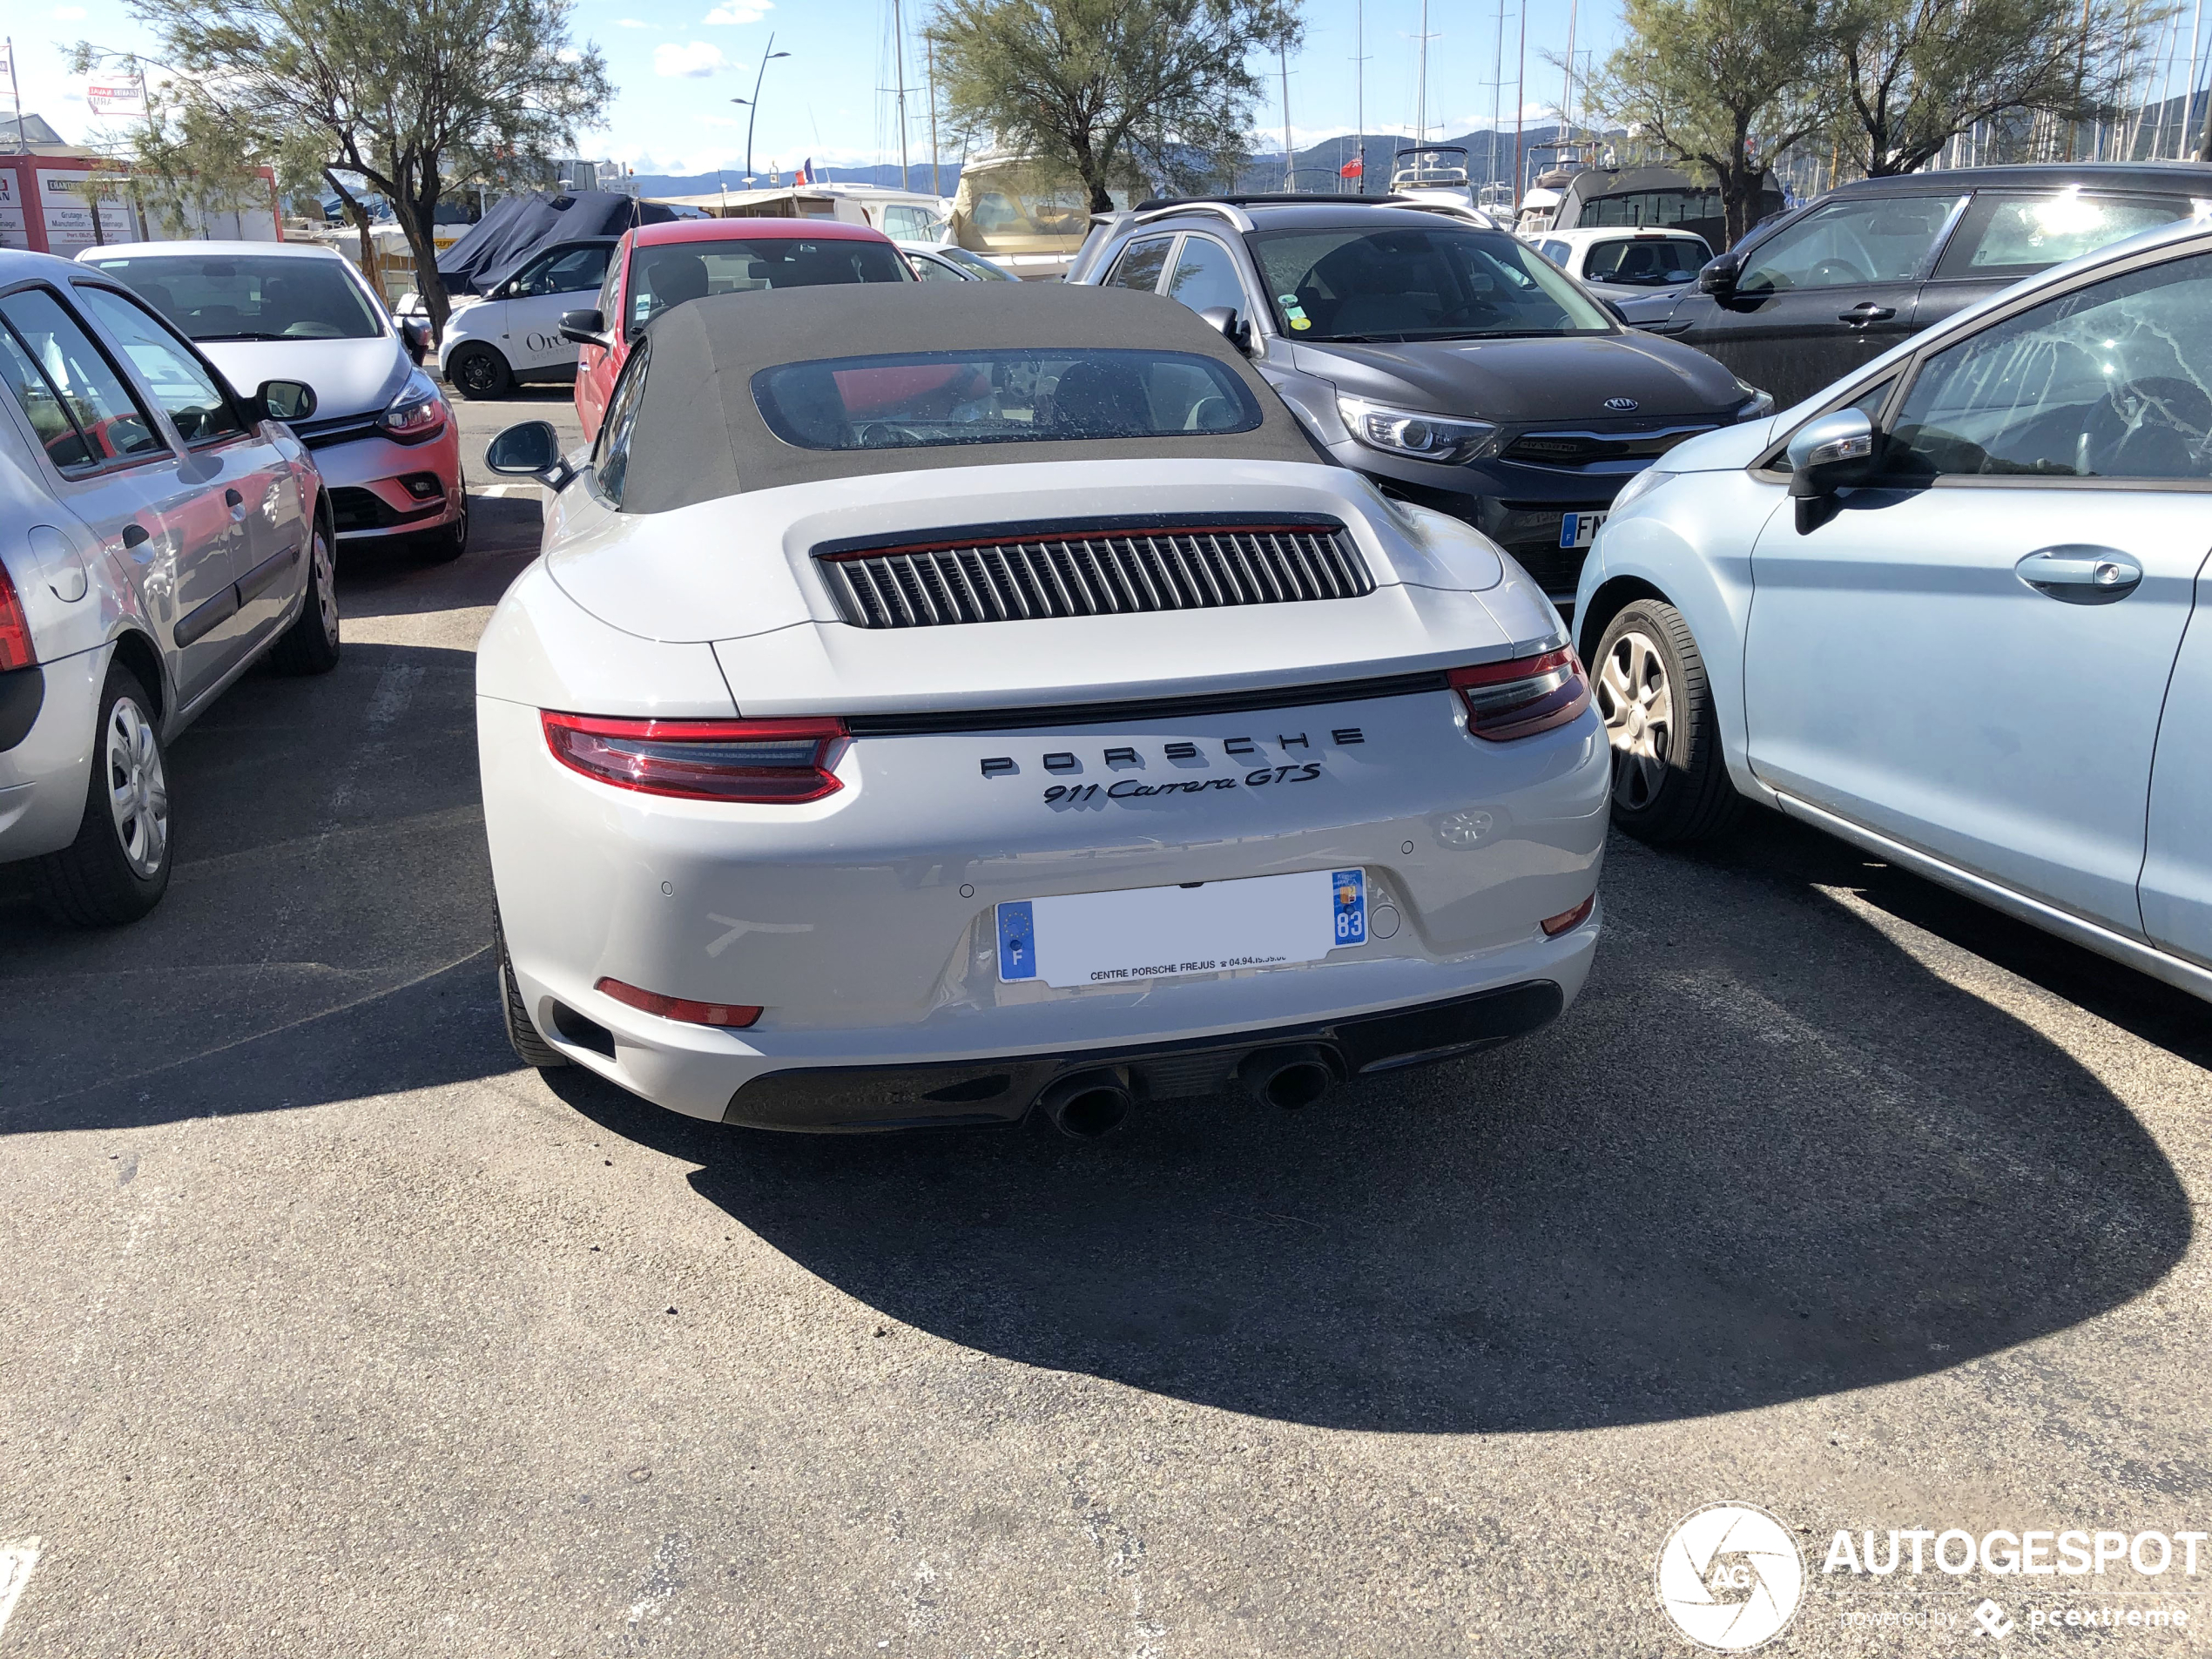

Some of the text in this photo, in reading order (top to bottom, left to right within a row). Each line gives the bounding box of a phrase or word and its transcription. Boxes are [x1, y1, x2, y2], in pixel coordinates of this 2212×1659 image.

[526, 332, 572, 352] Ore
[981, 728, 1365, 774] PORSCHE
[1043, 763, 1321, 804] 911 Carrera GTS
[1337, 911, 1363, 938] 83
[1012, 949, 1022, 965] F
[1090, 968, 1129, 981] CENTRE
[1132, 963, 1177, 976] PORSCHE
[1180, 961, 1216, 972] FREJUS
